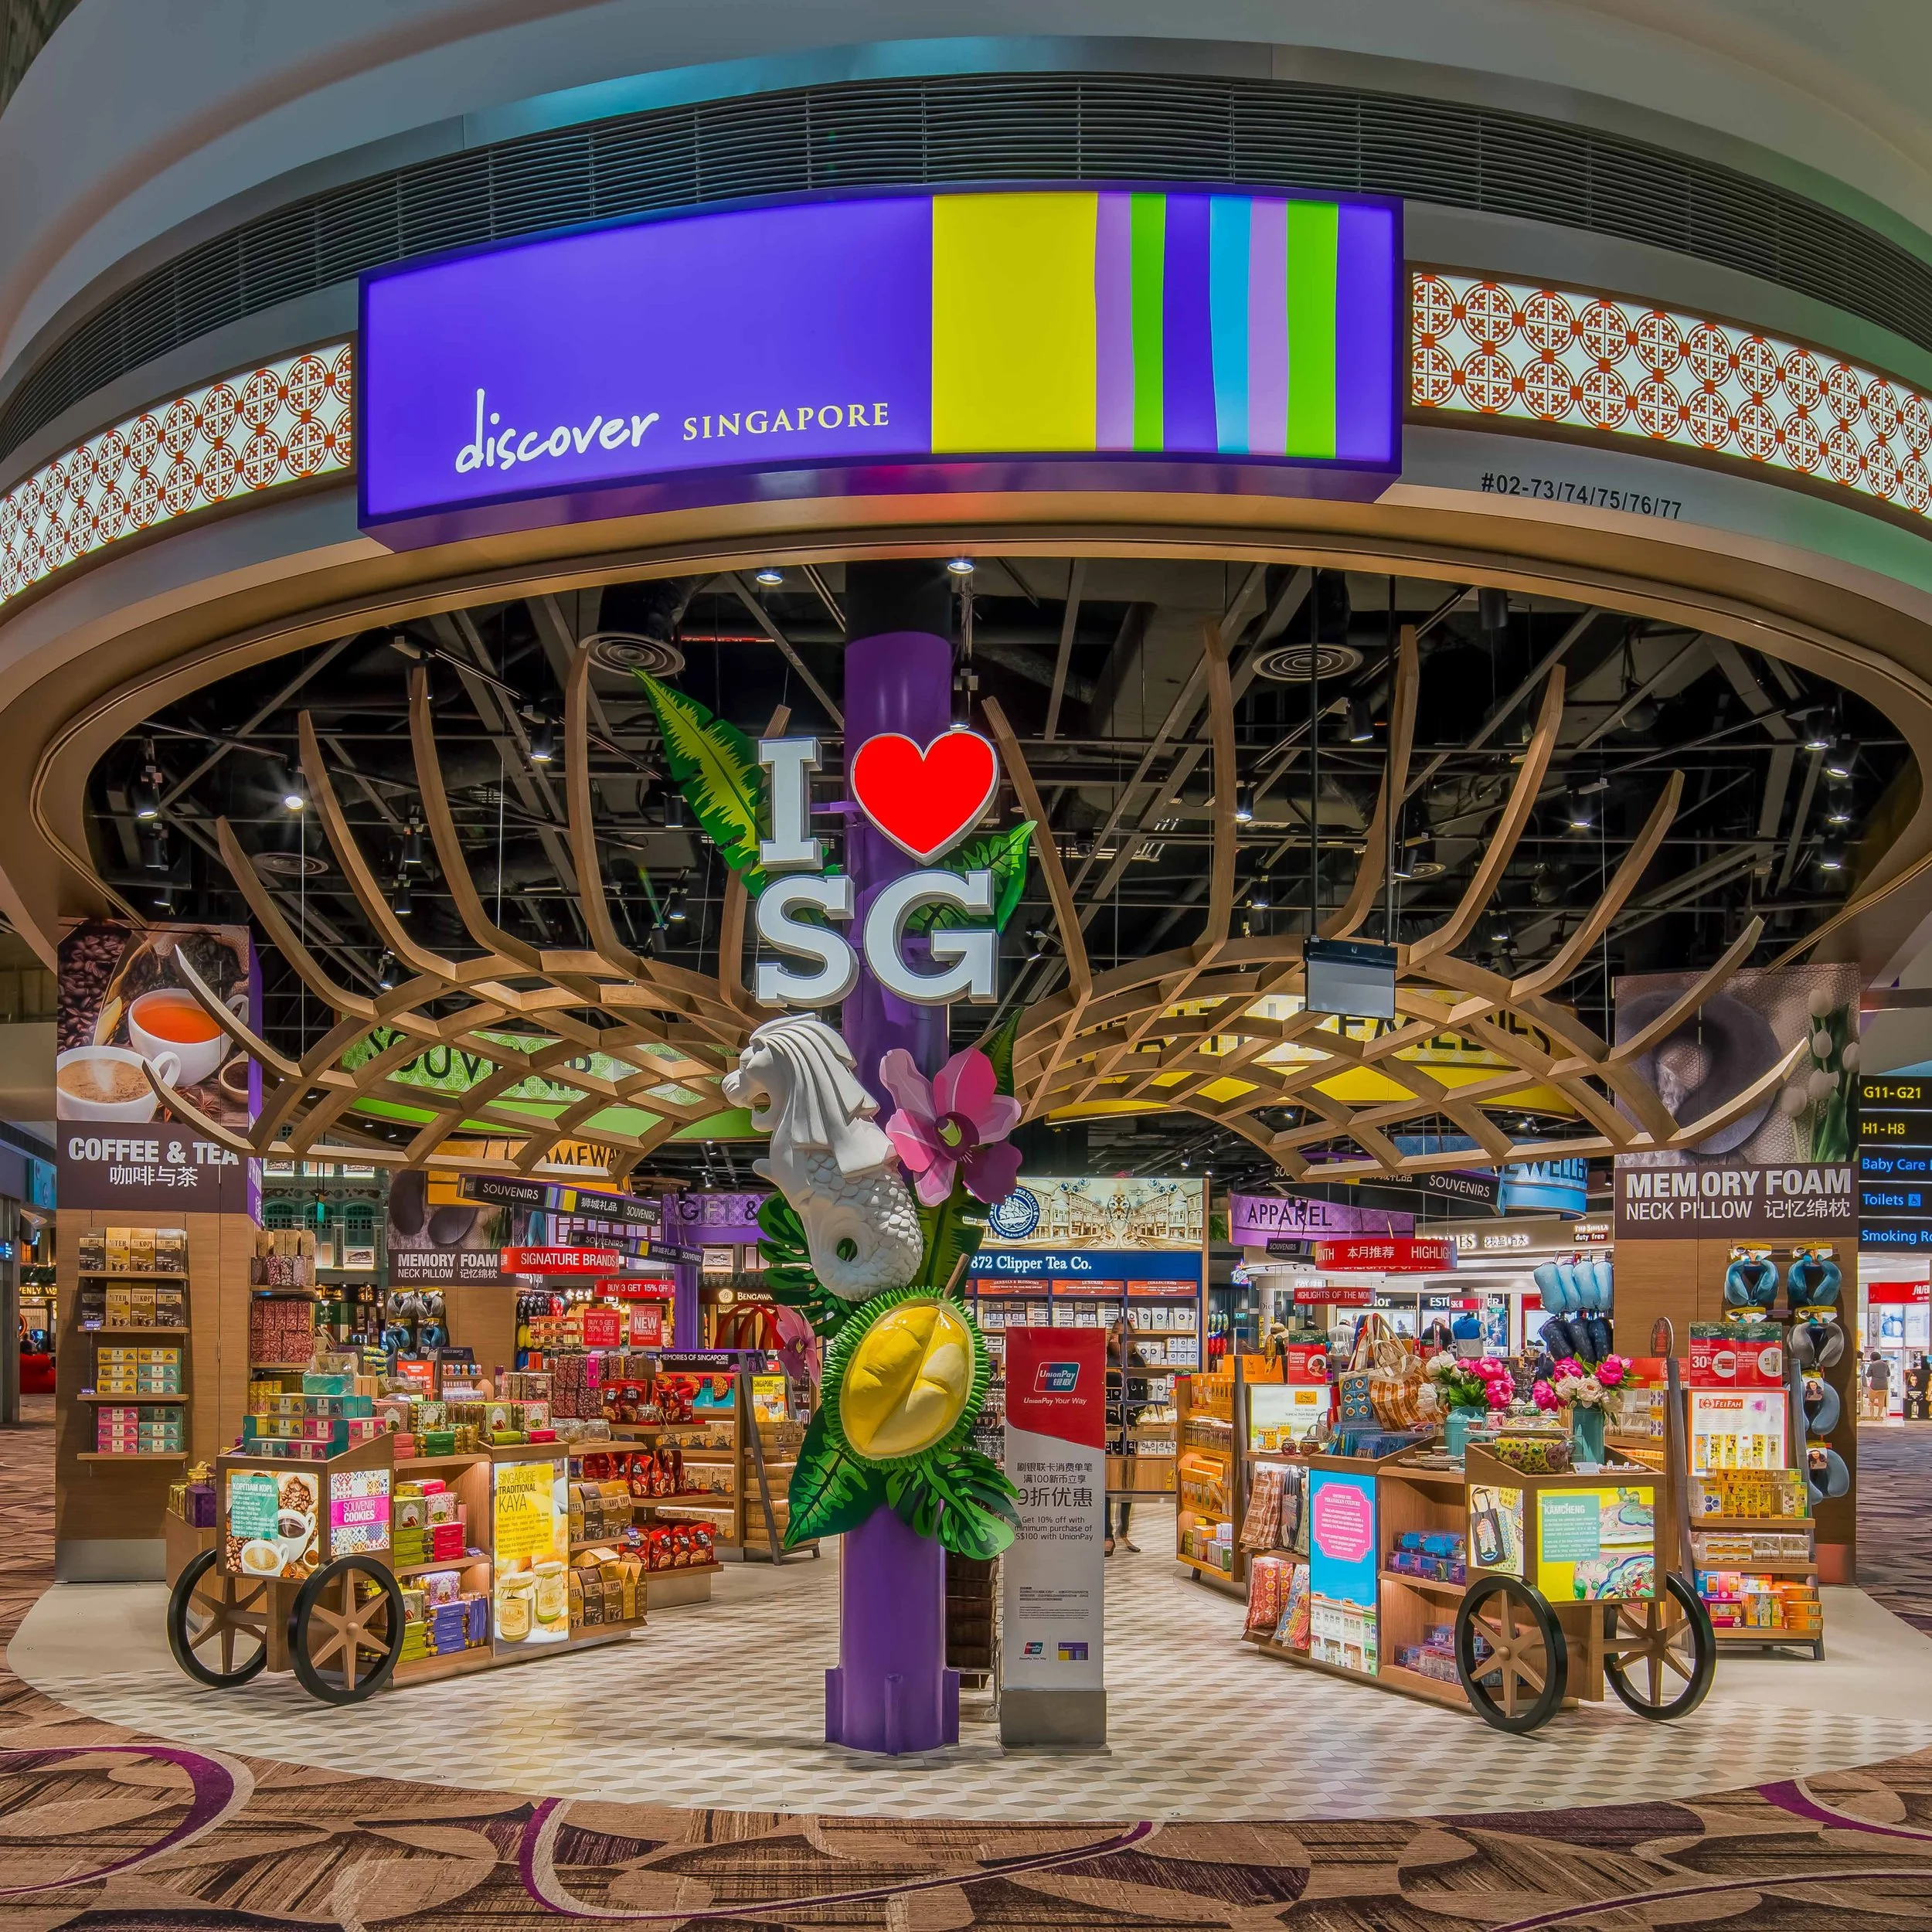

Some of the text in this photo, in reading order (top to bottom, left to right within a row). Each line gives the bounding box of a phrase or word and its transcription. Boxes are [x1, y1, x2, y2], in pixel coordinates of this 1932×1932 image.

[455, 388, 889, 473] discover SINGAPORE
[1481, 472, 1682, 520] #02-73/74/75/76/77
[755, 869, 998, 1008] SG
[68, 1137, 240, 1166] COFFEE & TEA
[1862, 1158, 1926, 1172] Baby Care
[110, 1165, 199, 1188] 咖啡与茶
[1626, 1168, 1852, 1199] MEMORY FOAM
[482, 1182, 539, 1200] SOUVENIRS
[1429, 1175, 1490, 1198] SOUVENIRS
[580, 1197, 617, 1213] 狮城礼品
[1862, 1193, 1904, 1206] Toilets
[626, 1205, 656, 1221] SOUVENIRS
[680, 1199, 758, 1221] GIFT &
[1247, 1203, 1332, 1226] APPAREL
[1626, 1200, 1753, 1220] NECK PILLOW
[1764, 1198, 1851, 1219] 记忆绵枕
[585, 1236, 624, 1247] SOUVENIRS
[1862, 1230, 1917, 1245] Smoking
[1269, 1242, 1297, 1251] SOUVENIRS
[1347, 1246, 1395, 1259] 本月推荐
[397, 1253, 456, 1267] MEMORY
[460, 1253, 498, 1267] FOAM
[521, 1252, 580, 1266] SIGNATURE
[583, 1253, 615, 1267] BRANDS
[682, 1250, 702, 1262] SOUVENIRS
[996, 1255, 1043, 1273] Clipper
[1046, 1256, 1067, 1269] Tea
[1071, 1256, 1092, 1269] Co.
[397, 1268, 454, 1278] NECK PILLOW
[459, 1268, 498, 1279] 记忆绵枕
[607, 1284, 668, 1292] BUY 3 GET 15% OFF
[1297, 1291, 1329, 1299] HIGHLIGHTS
[1332, 1291, 1342, 1299] OF
[1343, 1291, 1357, 1299] THE
[737, 1291, 774, 1301] BENGAWA
[634, 1317, 657, 1329] NEW
[659, 1353, 688, 1362] MEMORIES
[697, 1353, 729, 1362] SINGAPORE
[1039, 1369, 1076, 1379] UnionPay
[1053, 1378, 1072, 1386] 银联
[1023, 1397, 1053, 1406] UnionPay
[1072, 1397, 1087, 1406] Way
[1016, 1462, 1094, 1472] 刷银联卡消费单笔
[498, 1470, 536, 1485] SINGAPORE
[1023, 1474, 1086, 1484] 满100新币立享
[498, 1483, 537, 1495] TRADITIONAL
[498, 1493, 528, 1514] KAYA
[1017, 1487, 1093, 1507] 9折优惠
[342, 1499, 376, 1512] SOUVENIR
[343, 1509, 376, 1523] COOKIES
[1022, 1515, 1036, 1524] Get
[1037, 1515, 1053, 1524] 10%
[1049, 1524, 1082, 1534] purchase
[1059, 1532, 1094, 1542] UnionPay
